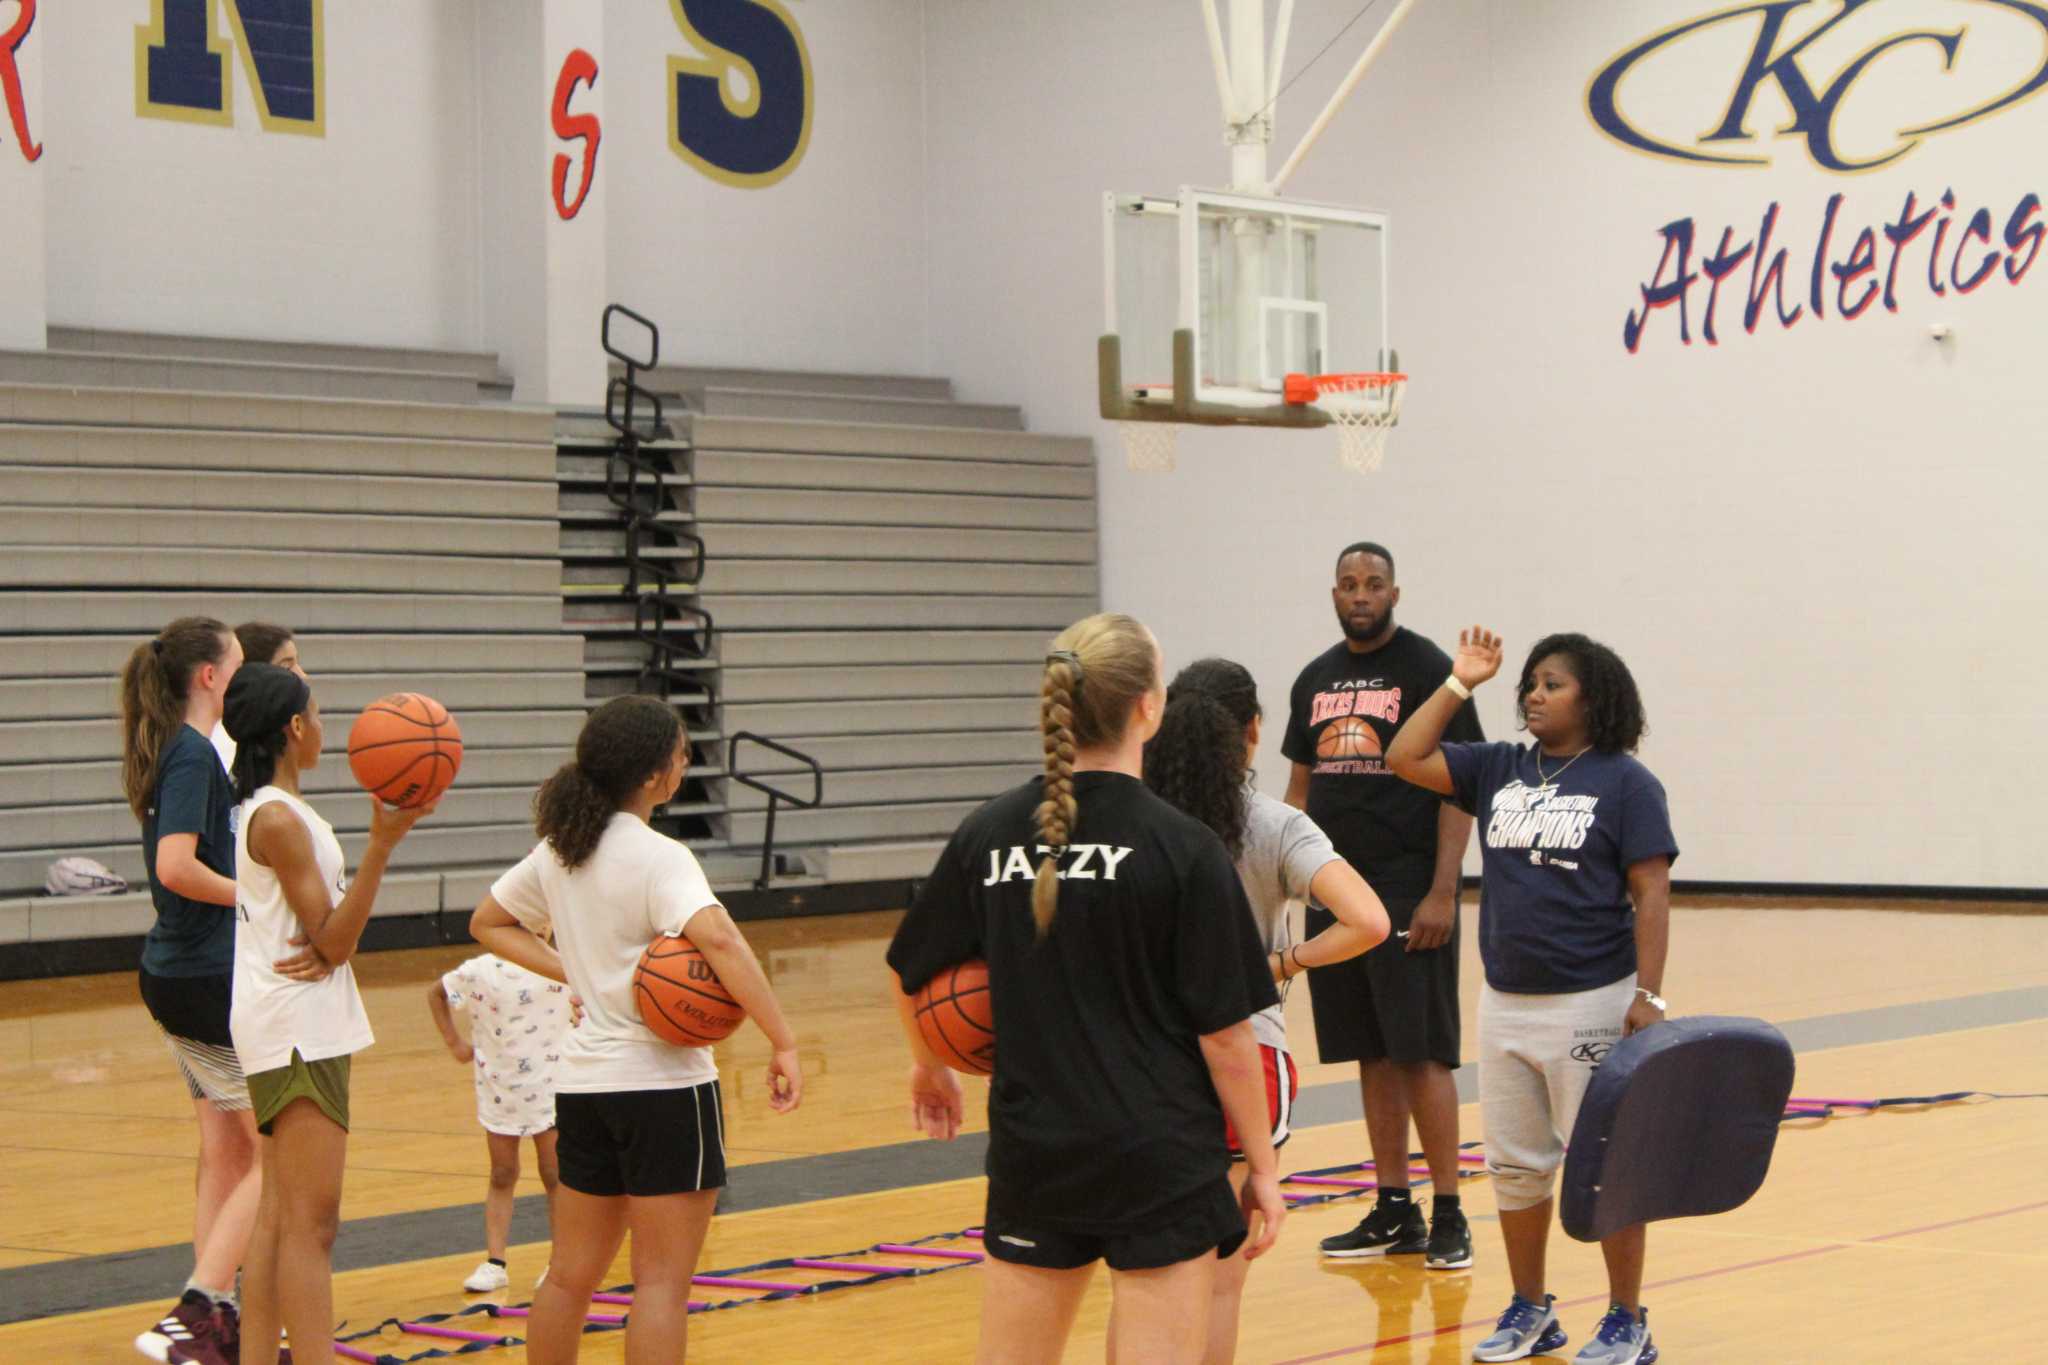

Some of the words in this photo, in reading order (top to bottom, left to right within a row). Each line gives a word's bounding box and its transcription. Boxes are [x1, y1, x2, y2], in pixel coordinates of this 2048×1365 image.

[551, 48, 600, 219] S
[1698, 0, 1969, 175] KC
[1624, 187, 2047, 353] Athletics
[1332, 678, 1384, 690] TABC
[1486, 810, 1595, 849] CHAMPIONS
